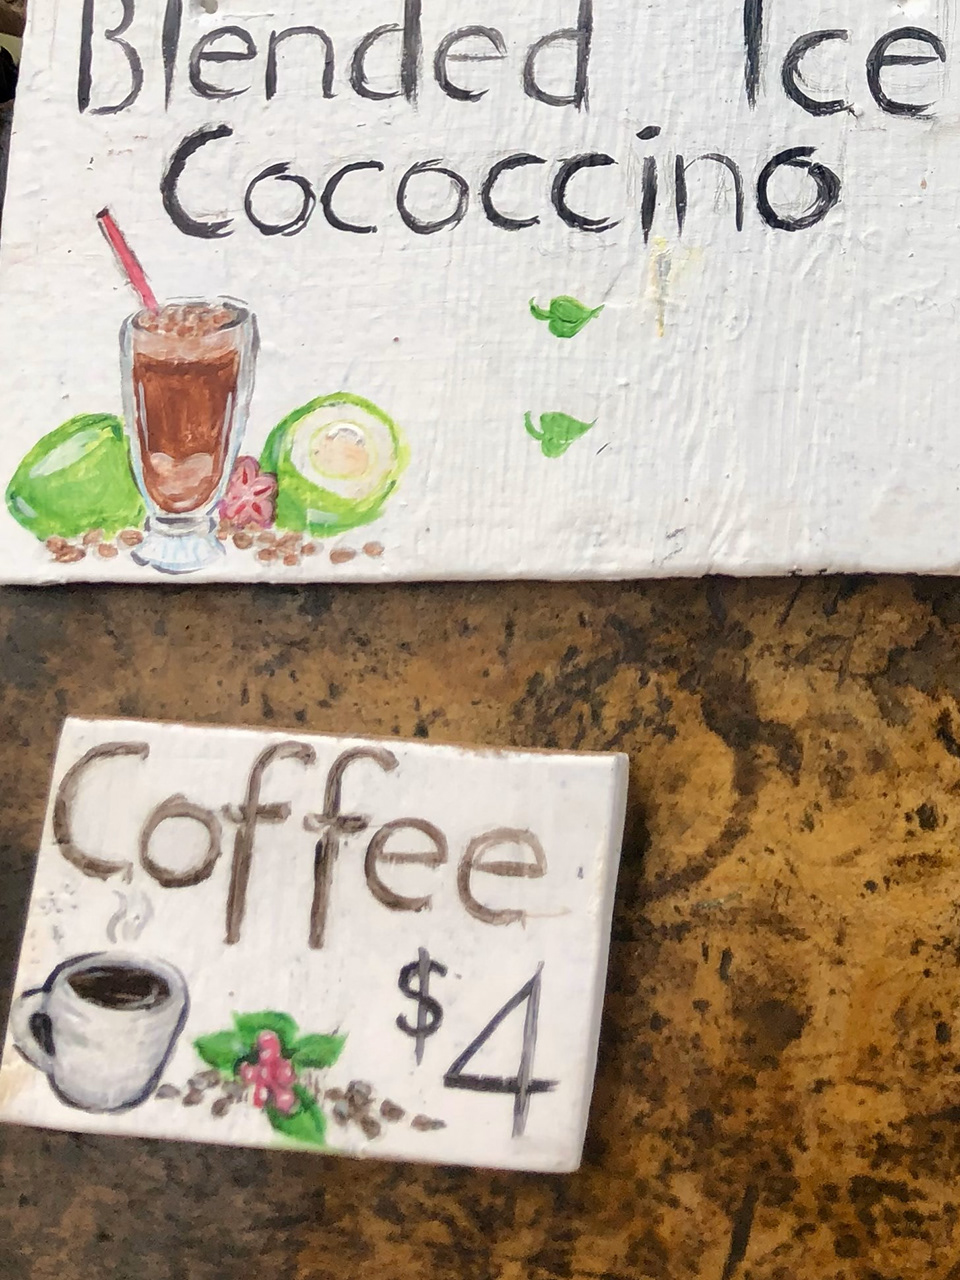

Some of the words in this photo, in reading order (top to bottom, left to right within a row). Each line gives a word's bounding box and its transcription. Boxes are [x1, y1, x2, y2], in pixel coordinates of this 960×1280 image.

[160, 124, 840, 243] Cococcino
[53, 741, 548, 948] Coffee
[396, 946, 560, 1137] $4
